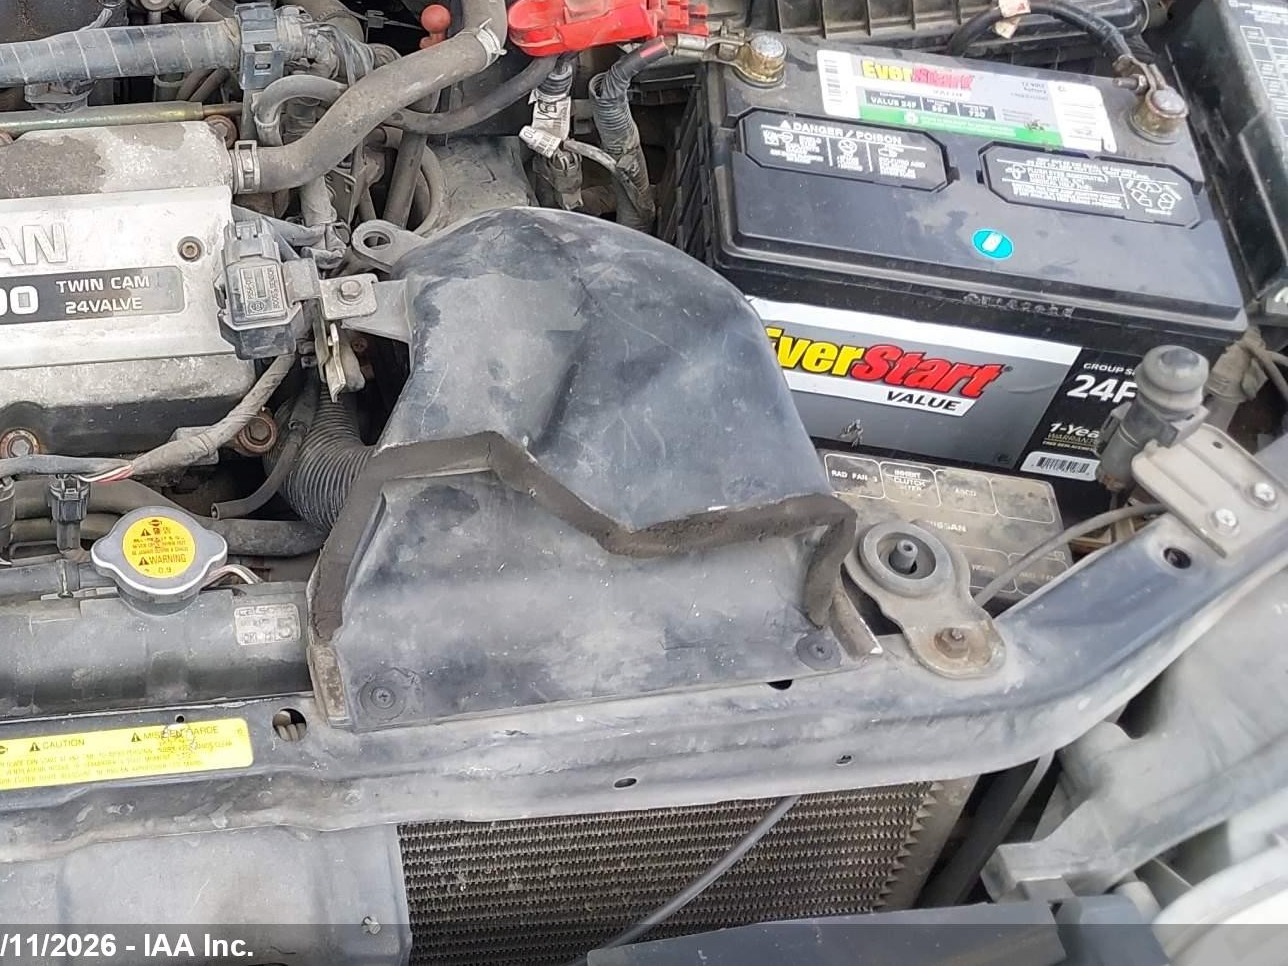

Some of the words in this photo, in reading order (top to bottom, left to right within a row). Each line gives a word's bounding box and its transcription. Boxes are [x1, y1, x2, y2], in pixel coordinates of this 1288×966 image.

[861, 58, 973, 91] EverStart
[793, 122, 843, 139] DANGER
[856, 130, 902, 145] POISON
[56, 278, 105, 294] TWIN
[111, 275, 151, 291] CAM
[65, 297, 143, 315] 24VALVE
[1083, 362, 1124, 374] GROUP
[1066, 374, 1139, 403] 24F
[885, 389, 962, 412] VALUE
[1050, 422, 1101, 439] 1-Yea
[831, 469, 848, 478] RAD
[852, 472, 868, 481] FAN
[148, 553, 187, 564] WARNING
[42, 738, 86, 750] CAUTION
